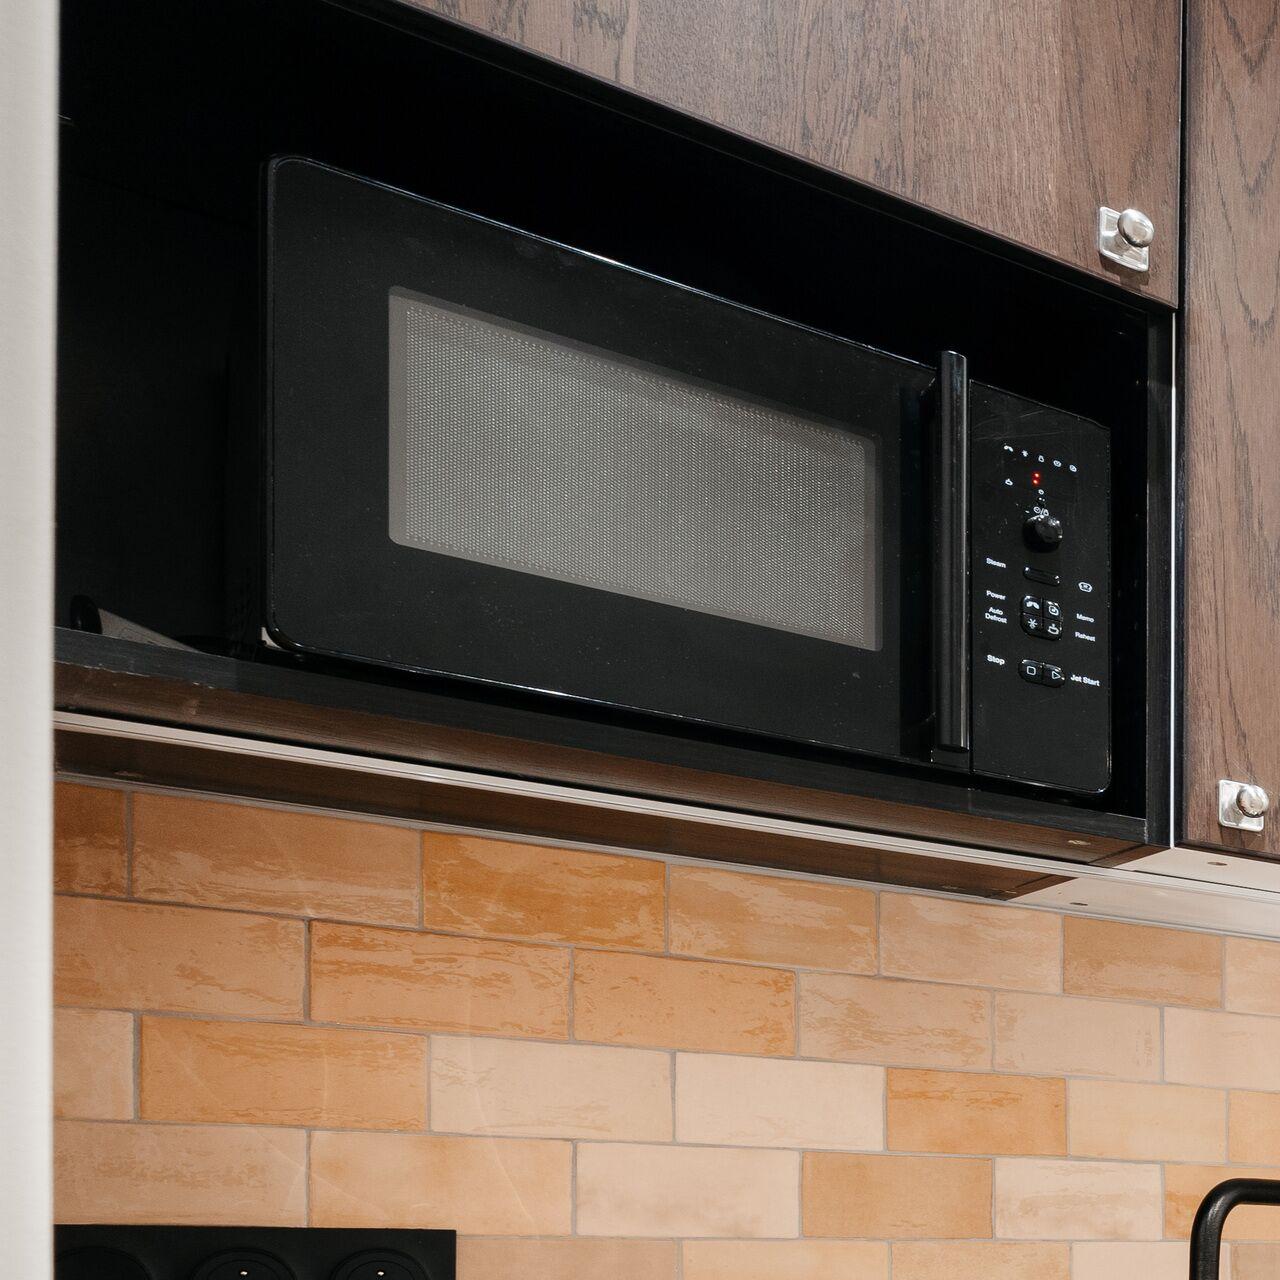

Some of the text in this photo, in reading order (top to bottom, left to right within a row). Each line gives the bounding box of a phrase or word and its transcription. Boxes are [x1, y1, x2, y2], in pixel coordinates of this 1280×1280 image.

[986, 590, 1006, 601] Power
[988, 606, 1004, 616] Auto
[985, 612, 1008, 624] Defrost
[987, 654, 1006, 666] Stop
[1070, 674, 1100, 687] Jet Start
